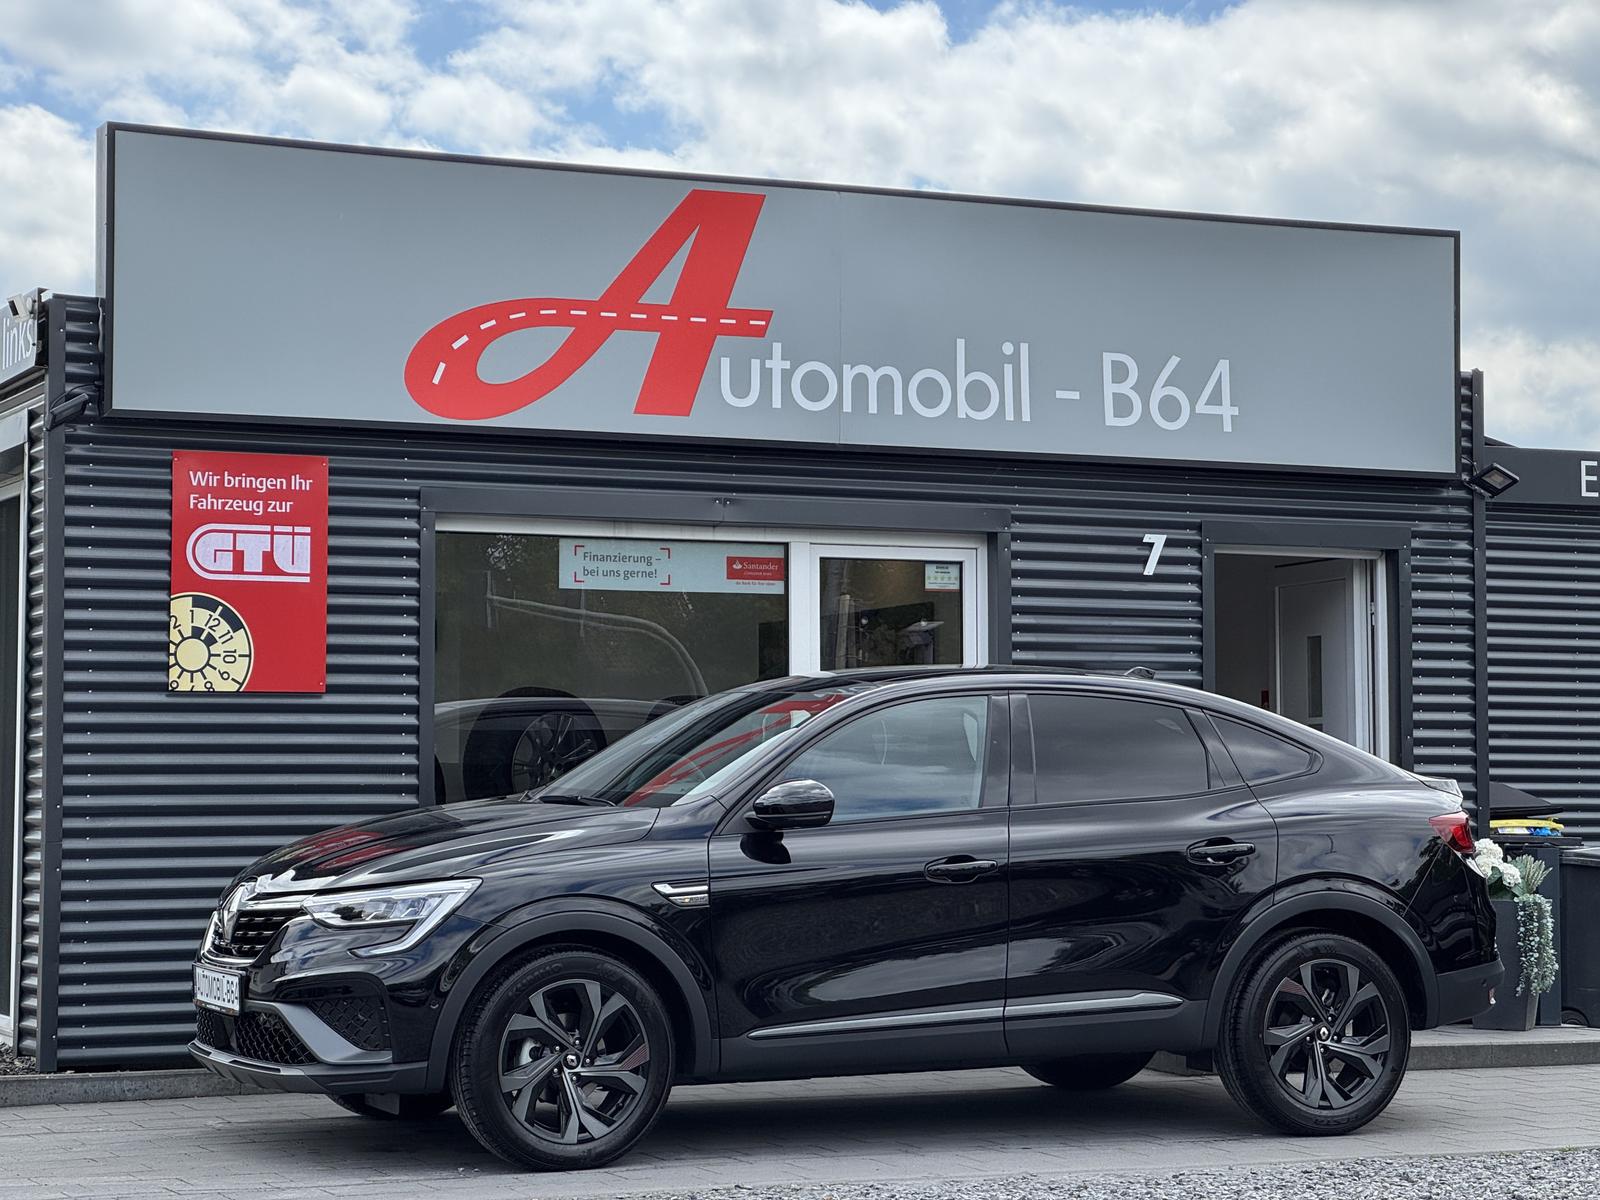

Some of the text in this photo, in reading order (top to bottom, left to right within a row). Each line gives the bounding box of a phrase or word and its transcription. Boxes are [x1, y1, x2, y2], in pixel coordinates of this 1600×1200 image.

[404, 189, 1031, 422] Automobil
[1102, 352, 1239, 432] B64
[189, 470, 313, 493] Wir bringen Ihr
[1580, 460, 1599, 497] E
[189, 493, 293, 515] Fahrzeug zur
[188, 523, 311, 579] GTÜ
[583, 551, 653, 567] Finanzierung
[1142, 534, 1167, 576] 7
[582, 566, 657, 580] bei uns gerne!
[743, 561, 778, 570] Santander
[169, 615, 182, 629] 2
[189, 609, 194, 624] 1
[205, 613, 221, 633] 12
[218, 629, 234, 645] 11
[222, 648, 237, 664] 10
